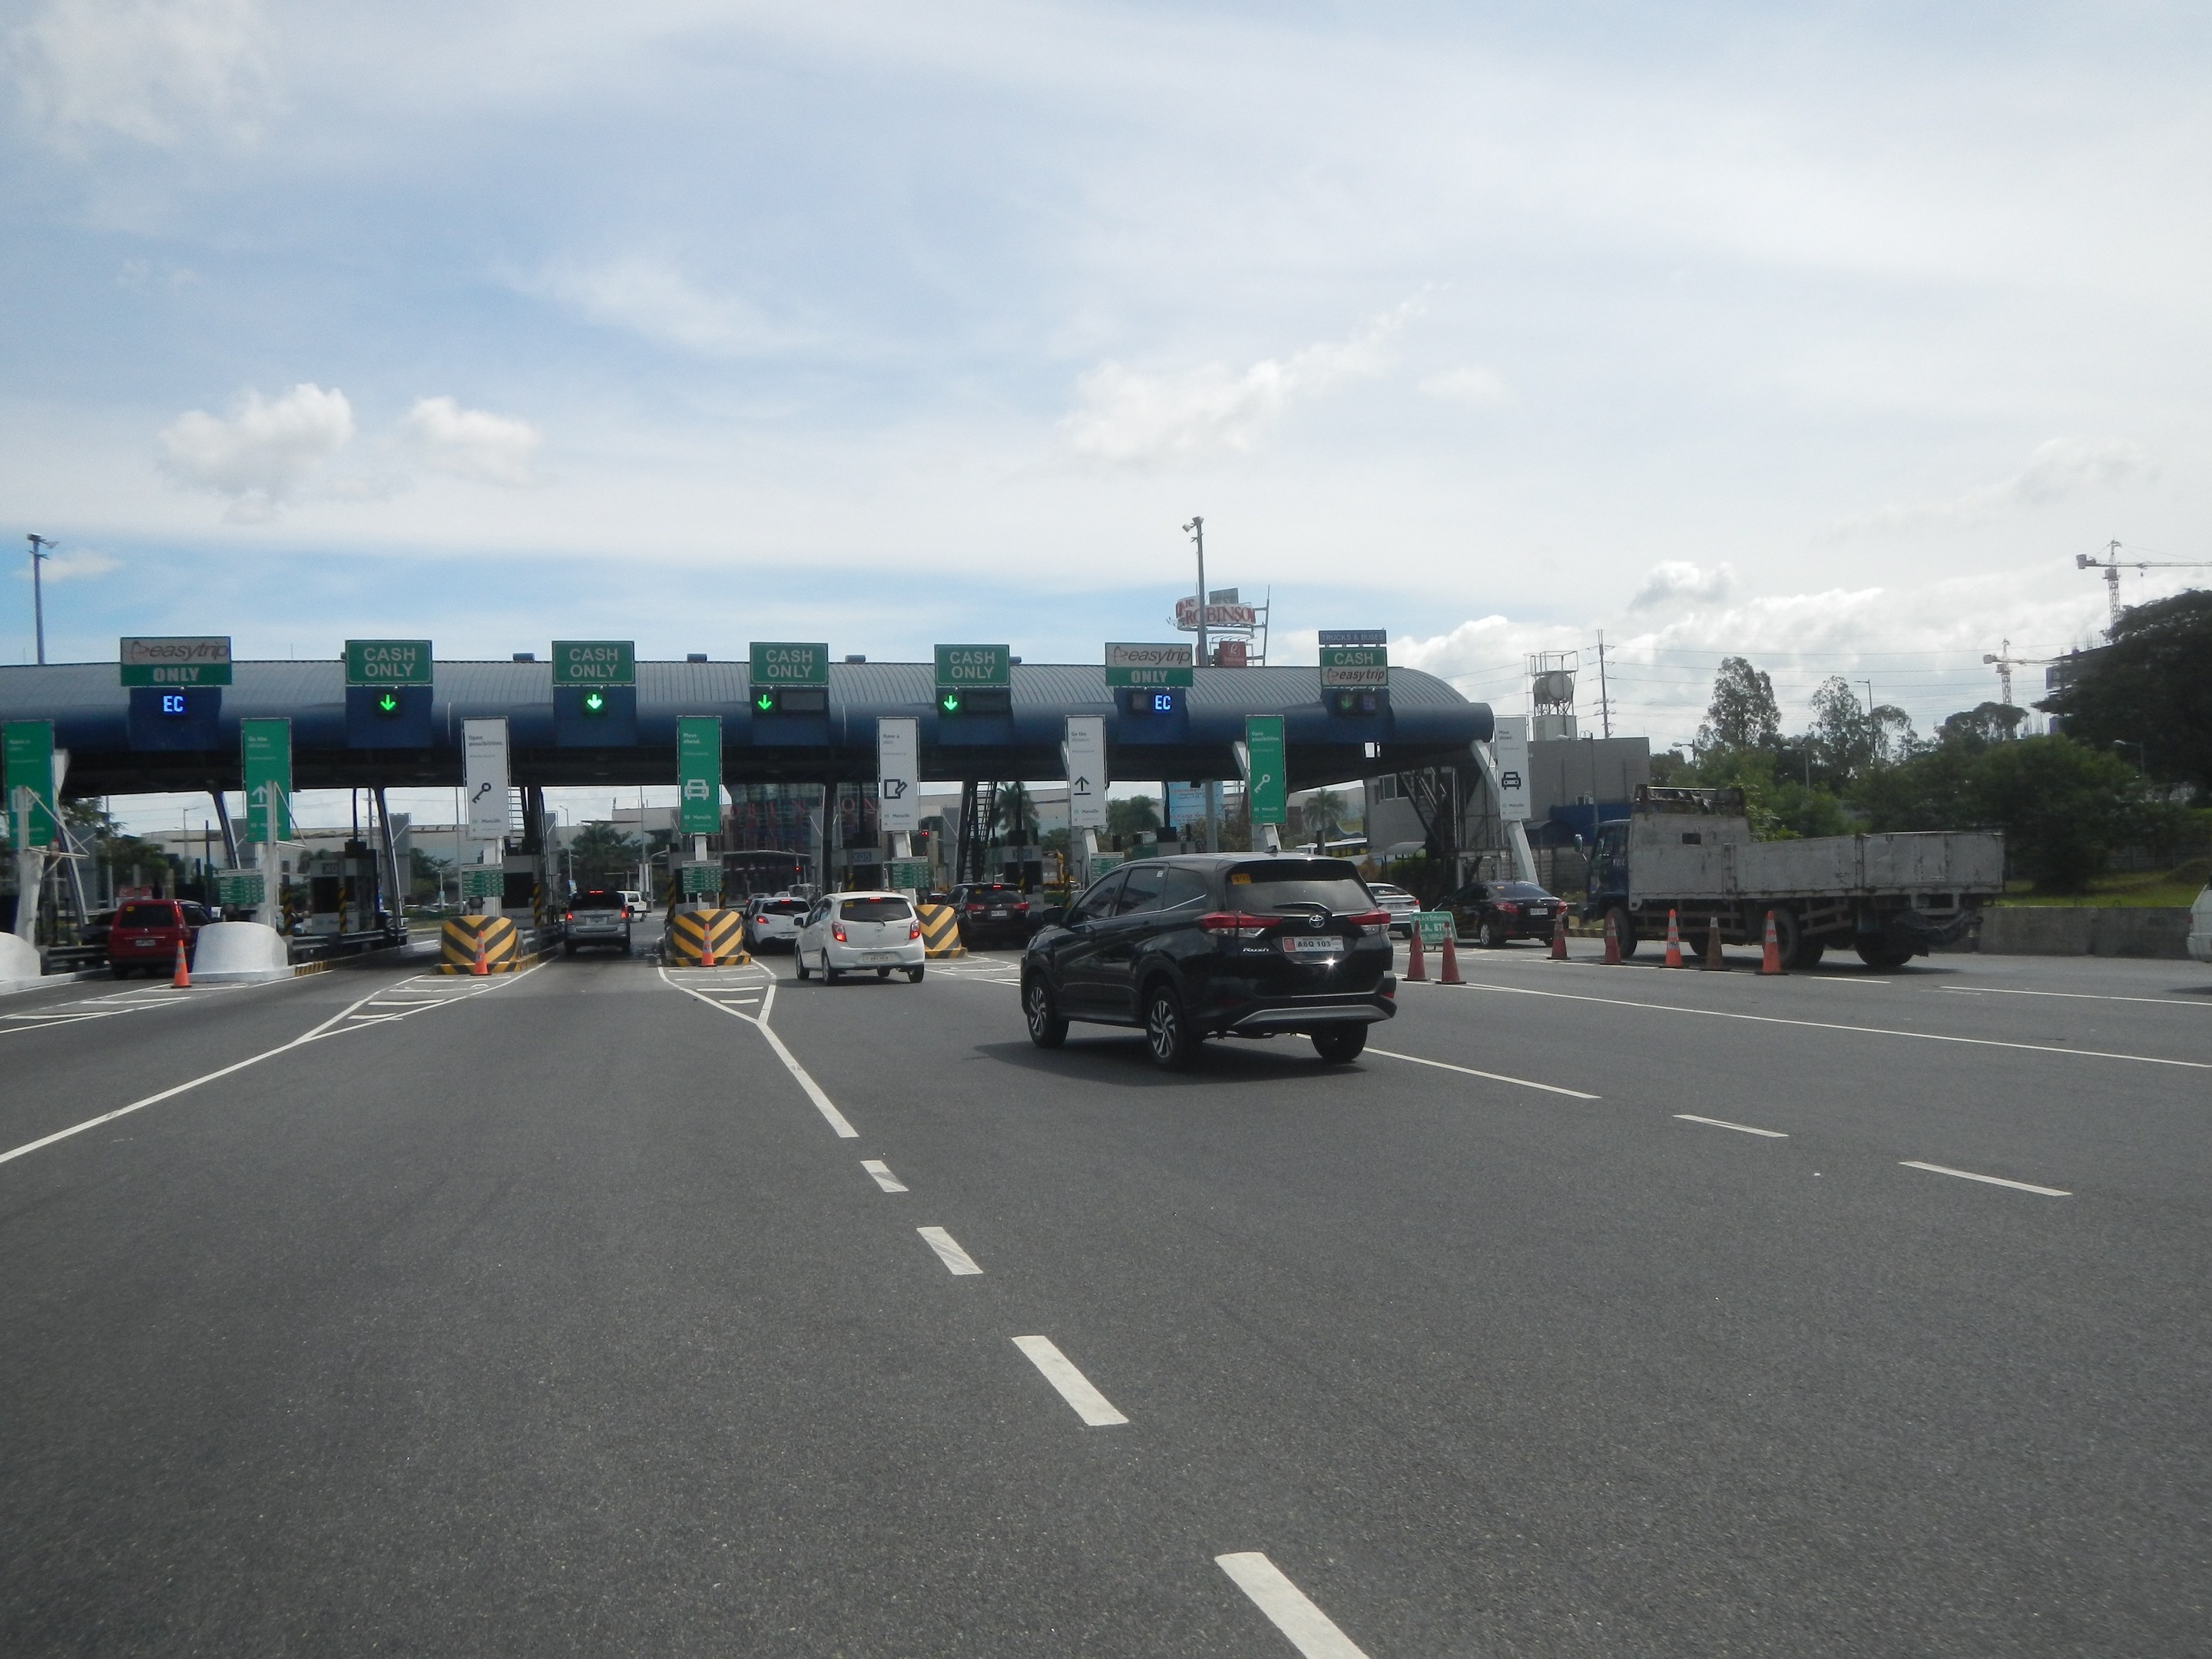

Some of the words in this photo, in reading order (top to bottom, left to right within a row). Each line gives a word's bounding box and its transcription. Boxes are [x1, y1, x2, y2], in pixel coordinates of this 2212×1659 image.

[149, 641, 229, 661] easytrip
[364, 647, 416, 661] CASH
[569, 647, 618, 661] CASH
[766, 649, 813, 663] CASH
[949, 651, 995, 664] CASH
[1128, 647, 1190, 665] easytrip
[1334, 652, 1374, 664] CASH
[154, 667, 200, 682] ONLY
[364, 663, 414, 677] ONLY
[570, 664, 618, 677] ONLY
[767, 664, 813, 678] ONLY
[951, 666, 994, 679] ONLY
[1131, 671, 1167, 683] ONLY
[163, 695, 184, 712] EC
[1154, 694, 1171, 710] EC
